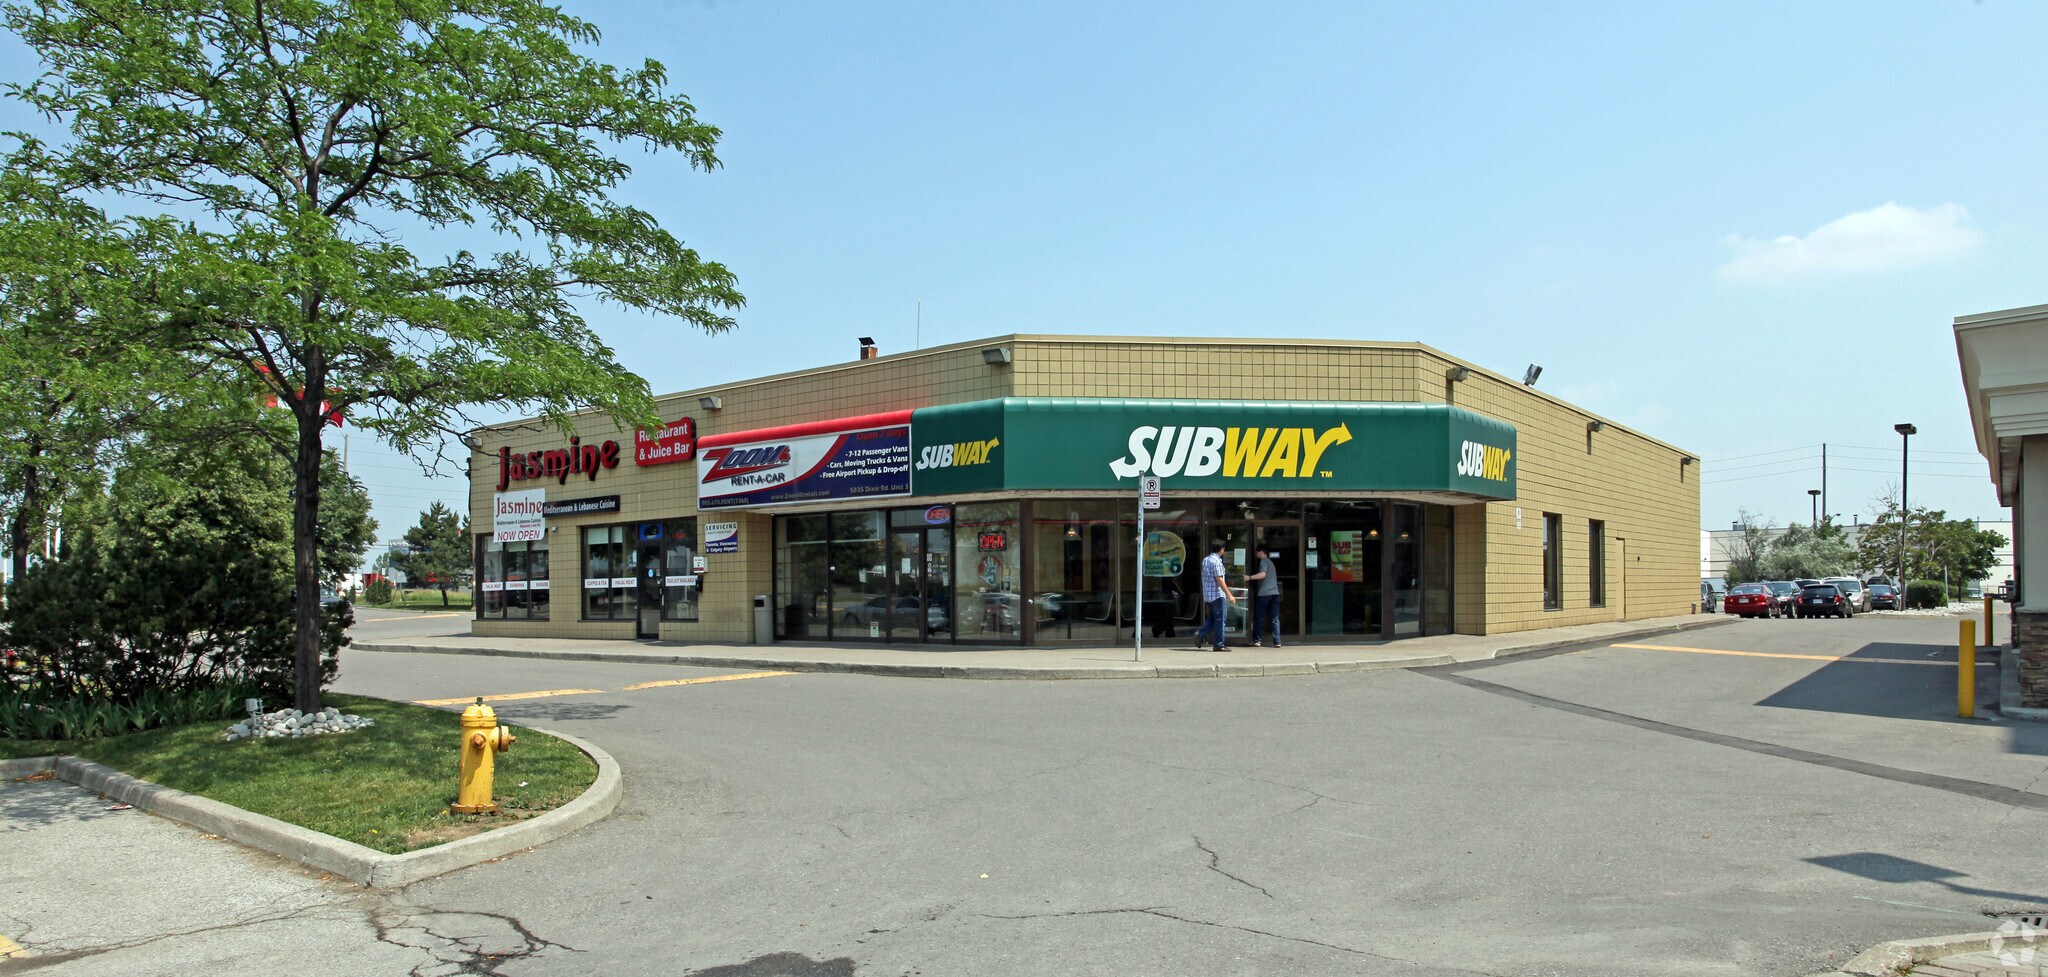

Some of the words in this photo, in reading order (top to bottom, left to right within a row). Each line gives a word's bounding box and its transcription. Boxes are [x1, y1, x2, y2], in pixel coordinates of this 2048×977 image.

[639, 423, 688, 442] Retaurant
[856, 432, 879, 441] Open
[887, 427, 907, 437] Days
[639, 449, 646, 460] &
[648, 446, 672, 459] Juice
[674, 442, 690, 455] Bar
[862, 447, 892, 456] Passenger
[915, 436, 1000, 471] SUBWAY
[1109, 421, 1353, 481] SUBWAY
[496, 435, 621, 491] Jasmine
[702, 445, 791, 484] ZOOM
[844, 460, 866, 468] Moving
[866, 457, 886, 465] Trucks
[1456, 440, 1511, 481] SUBWAY
[836, 469, 857, 478] Airport
[857, 467, 877, 476] Pickup
[883, 464, 909, 474] Drop-off
[731, 472, 786, 487] RENT-A-CAR
[496, 496, 542, 517] Jasmine
[544, 505, 573, 514] Mediterranean
[574, 503, 578, 511] &
[579, 502, 599, 511] Lebanese
[600, 500, 616, 509] Cuisine
[705, 523, 737, 531] SERVICING
[497, 531, 516, 541] NOW
[518, 530, 540, 540] OPEN
[980, 535, 1003, 549] OPEN
[1332, 541, 1351, 550] SUB
